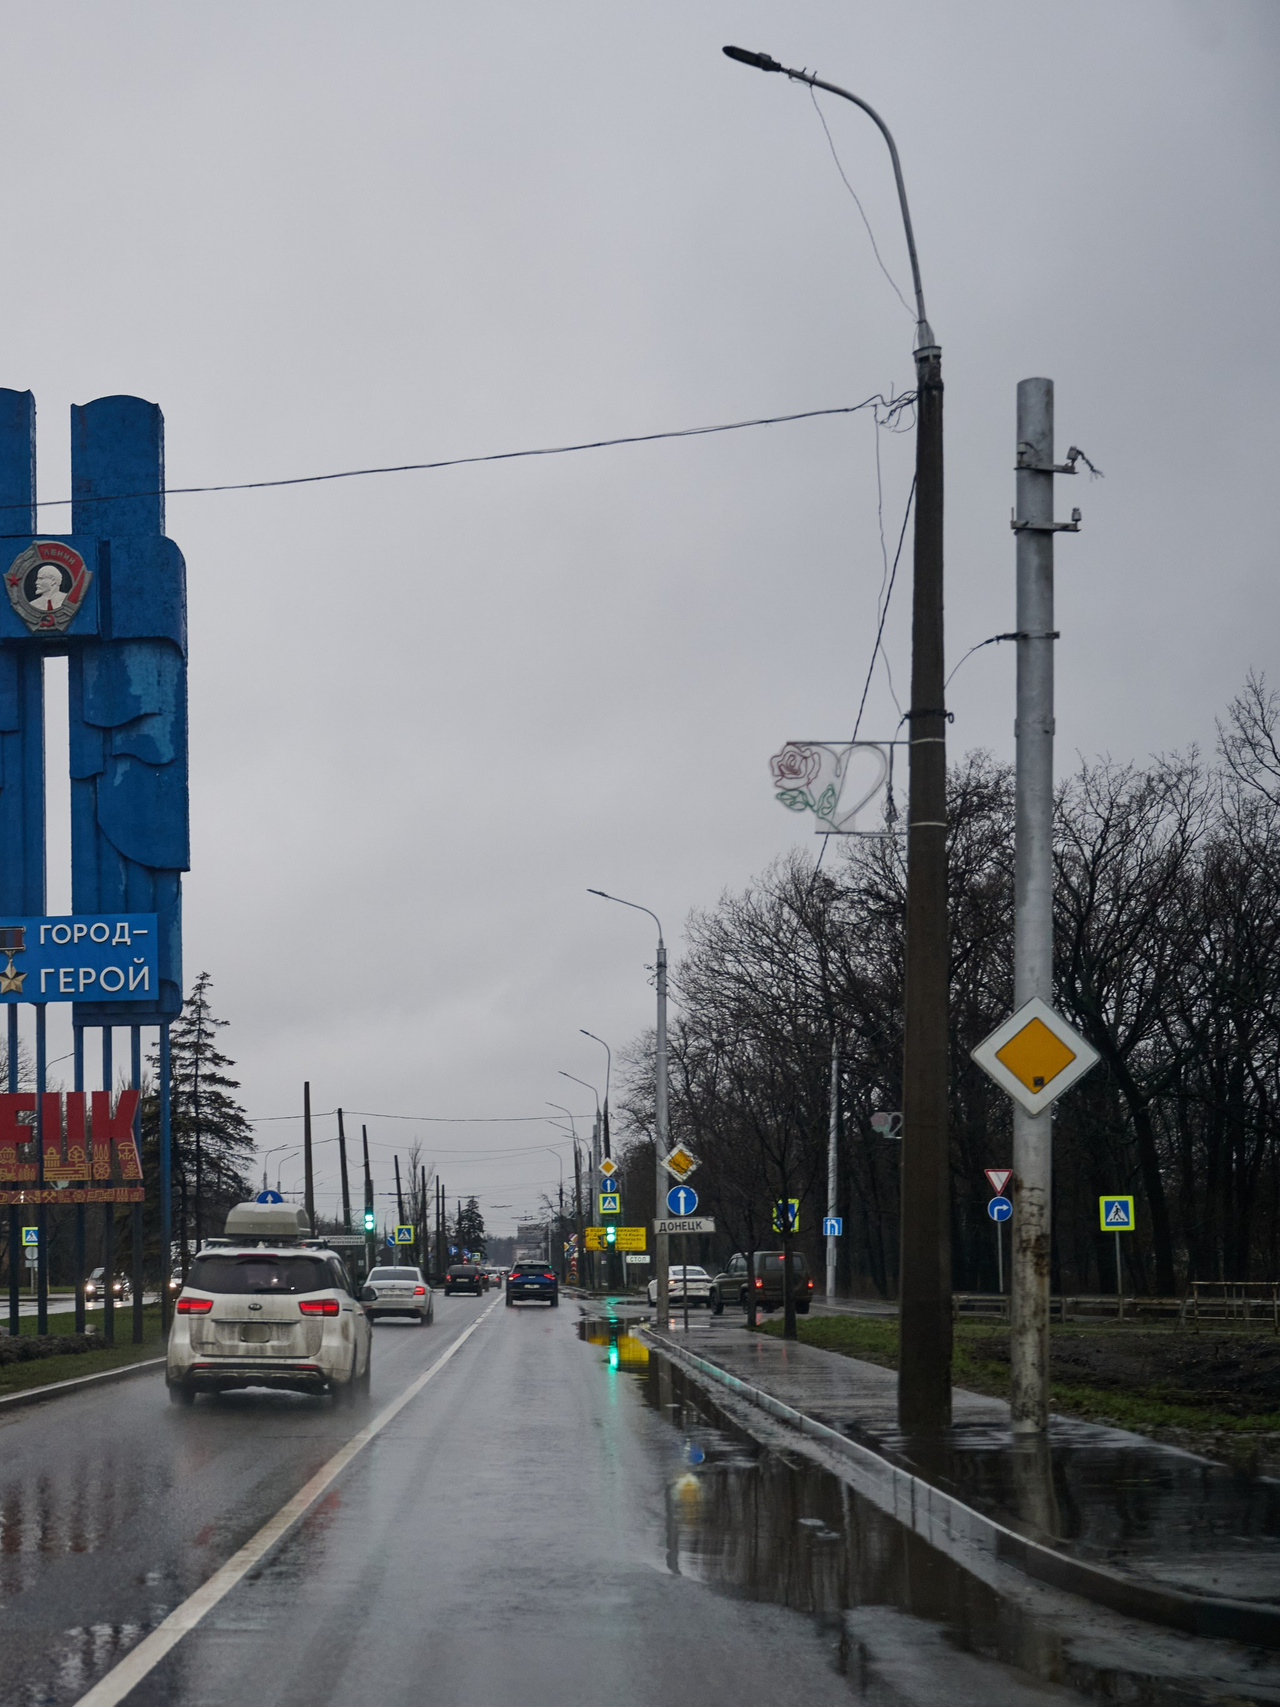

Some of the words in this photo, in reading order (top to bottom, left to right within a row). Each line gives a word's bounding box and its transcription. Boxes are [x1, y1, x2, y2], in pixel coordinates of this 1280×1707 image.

[43, 548, 75, 564] ЛЕНИН
[40, 957, 150, 993] ГЕРОЙ
[658, 1221, 703, 1232] ДОНЕЦК
